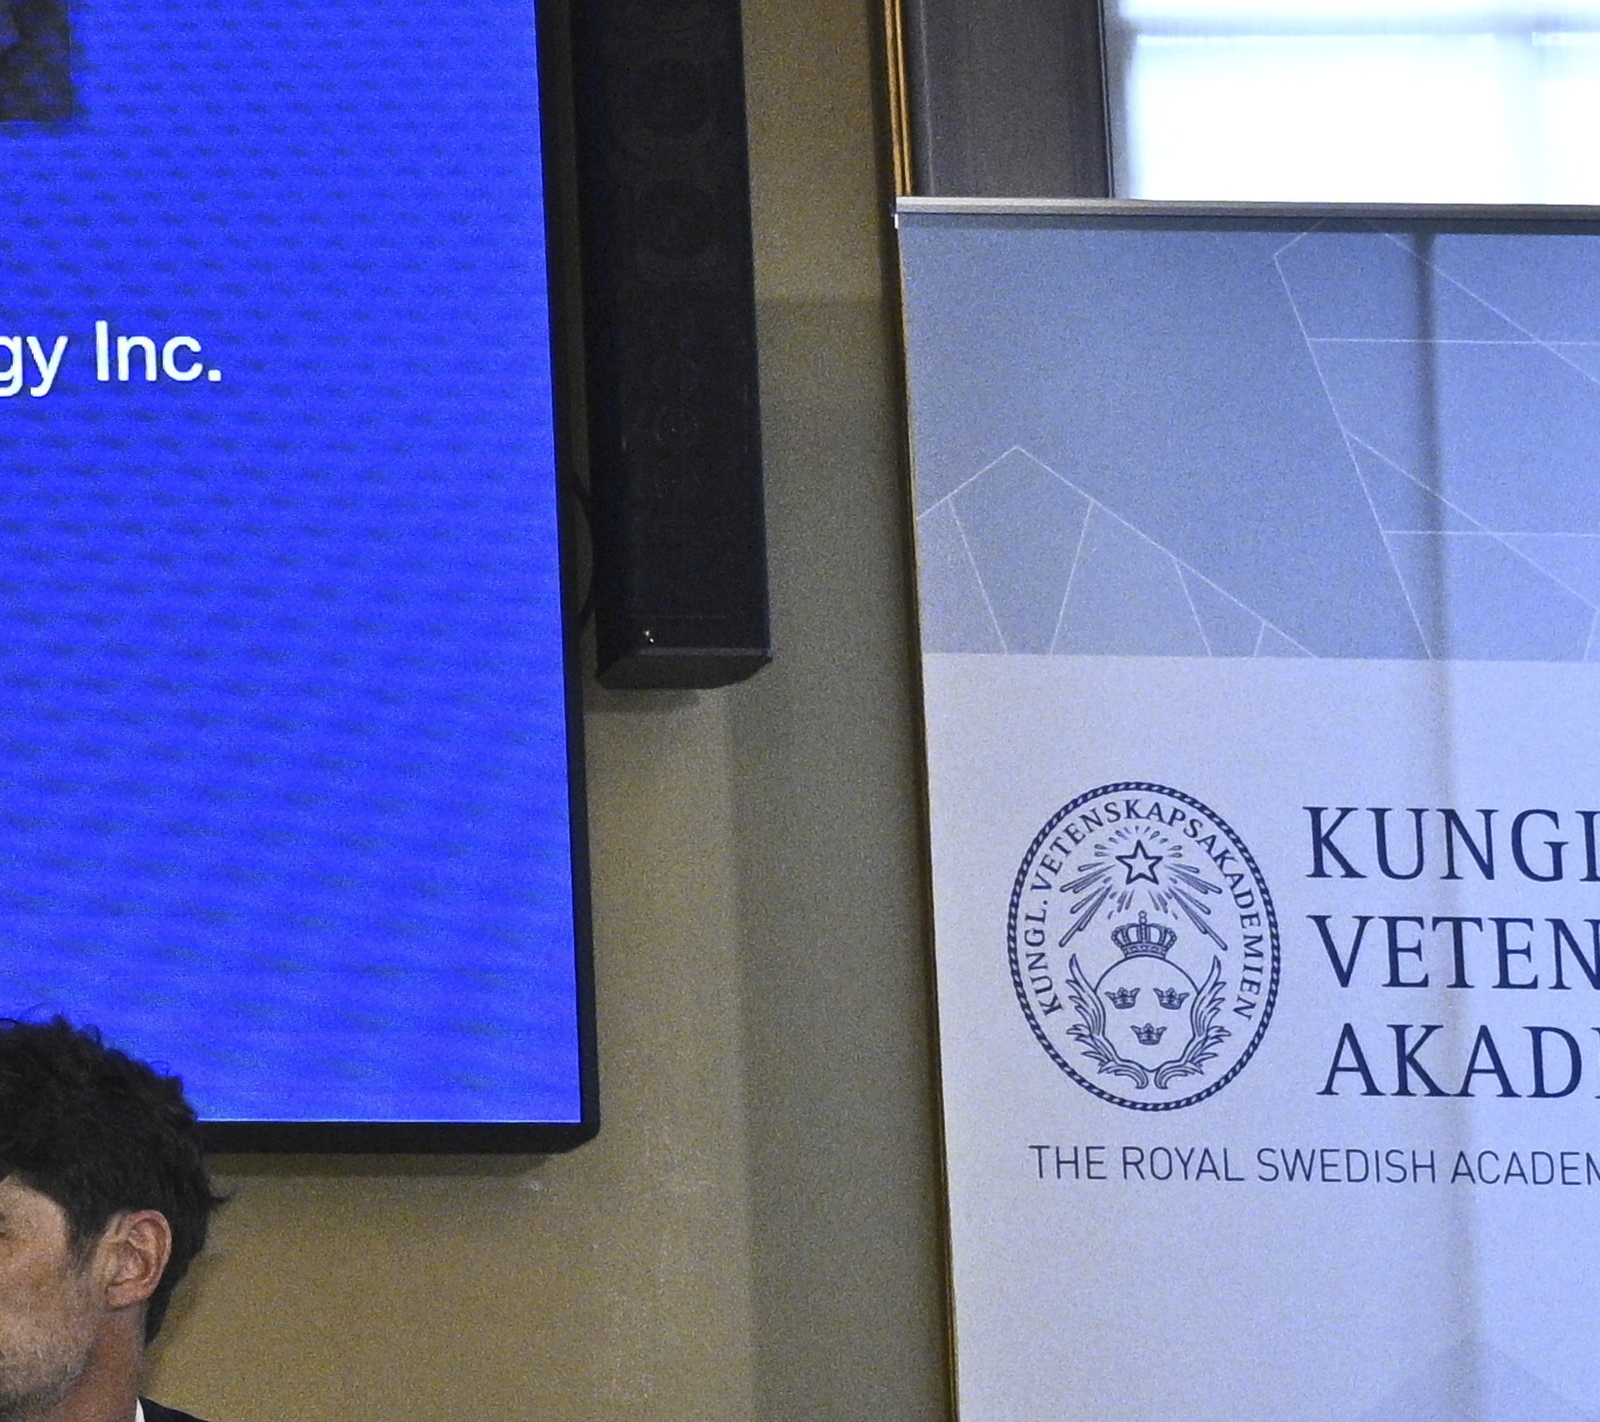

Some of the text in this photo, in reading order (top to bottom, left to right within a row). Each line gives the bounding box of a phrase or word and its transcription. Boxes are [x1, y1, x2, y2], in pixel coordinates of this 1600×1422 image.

[96, 321, 221, 381] Inc.
[1030, 798, 1264, 1020] VETENSKAPSAKADEMIEN
[1316, 1023, 1600, 1098] AKAD
[1028, 1145, 1107, 1180] THE
[1122, 1146, 1246, 1182] ROYAL
[1257, 1147, 1436, 1184] SWEDISH
